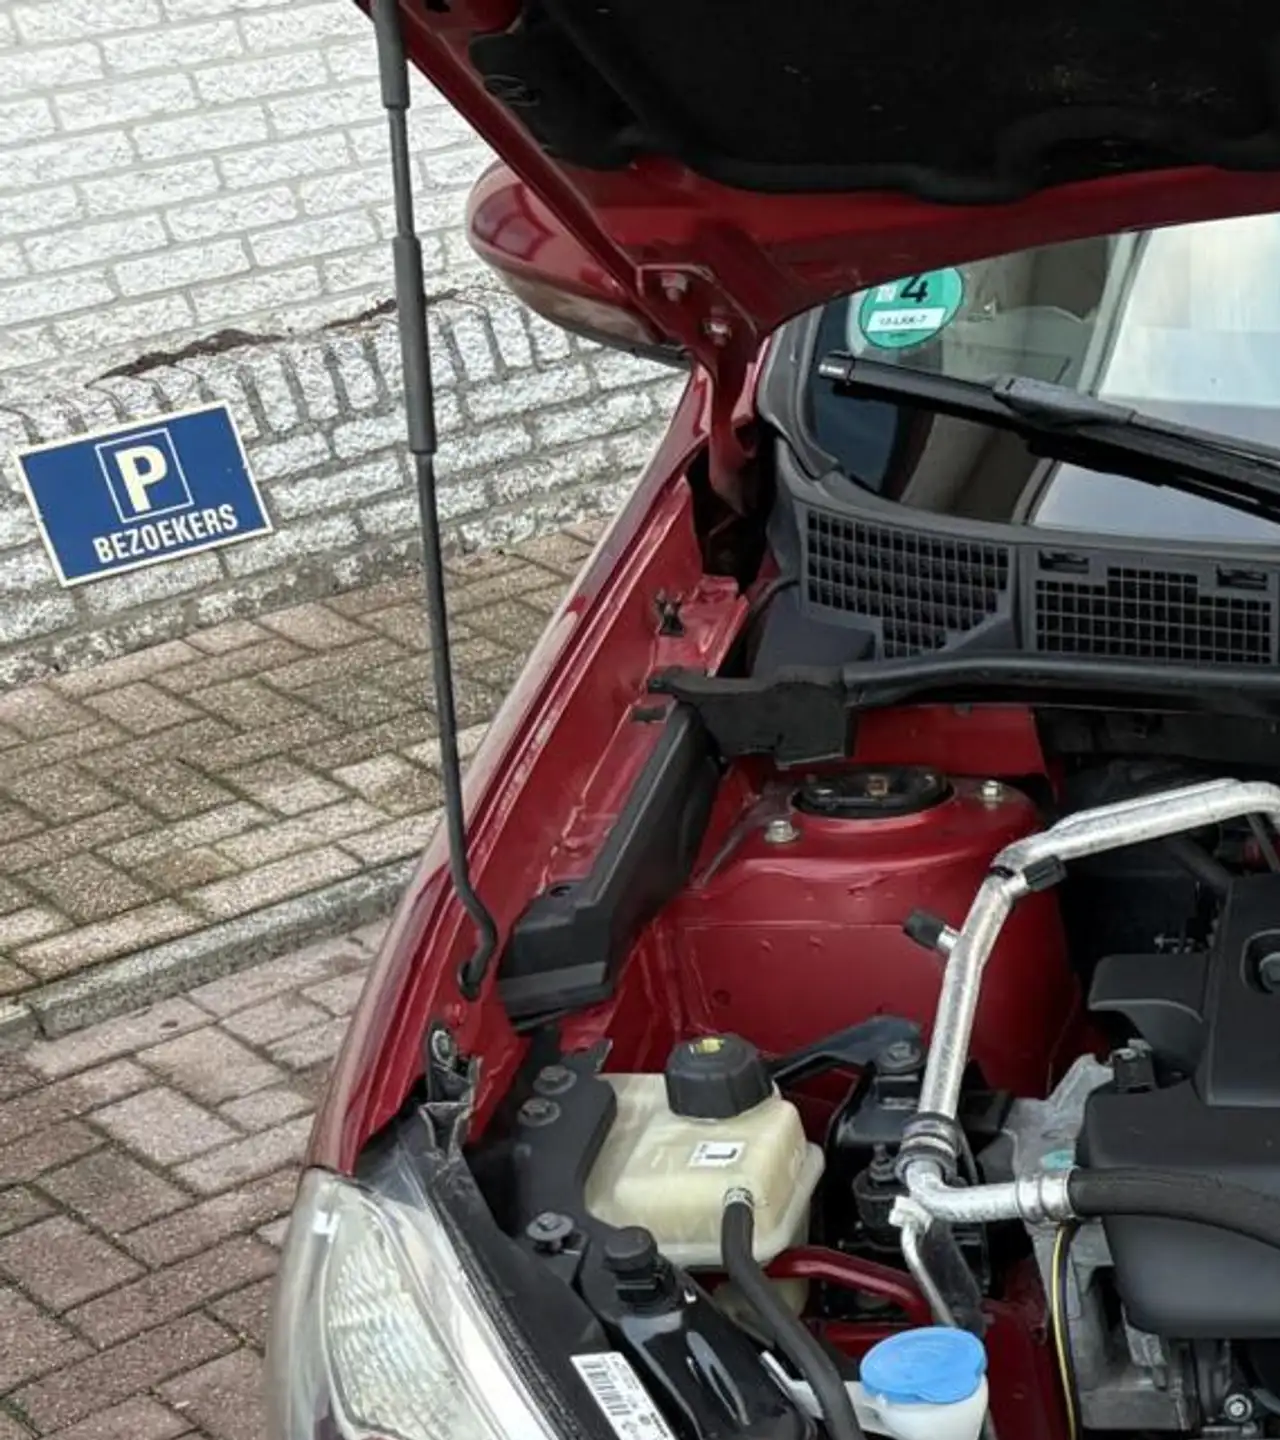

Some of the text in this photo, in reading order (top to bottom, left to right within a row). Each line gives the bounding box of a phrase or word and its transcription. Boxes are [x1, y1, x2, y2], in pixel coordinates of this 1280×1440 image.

[900, 276, 929, 303] 4
[115, 445, 168, 513] P
[92, 504, 239, 564] BEZOEKERS
